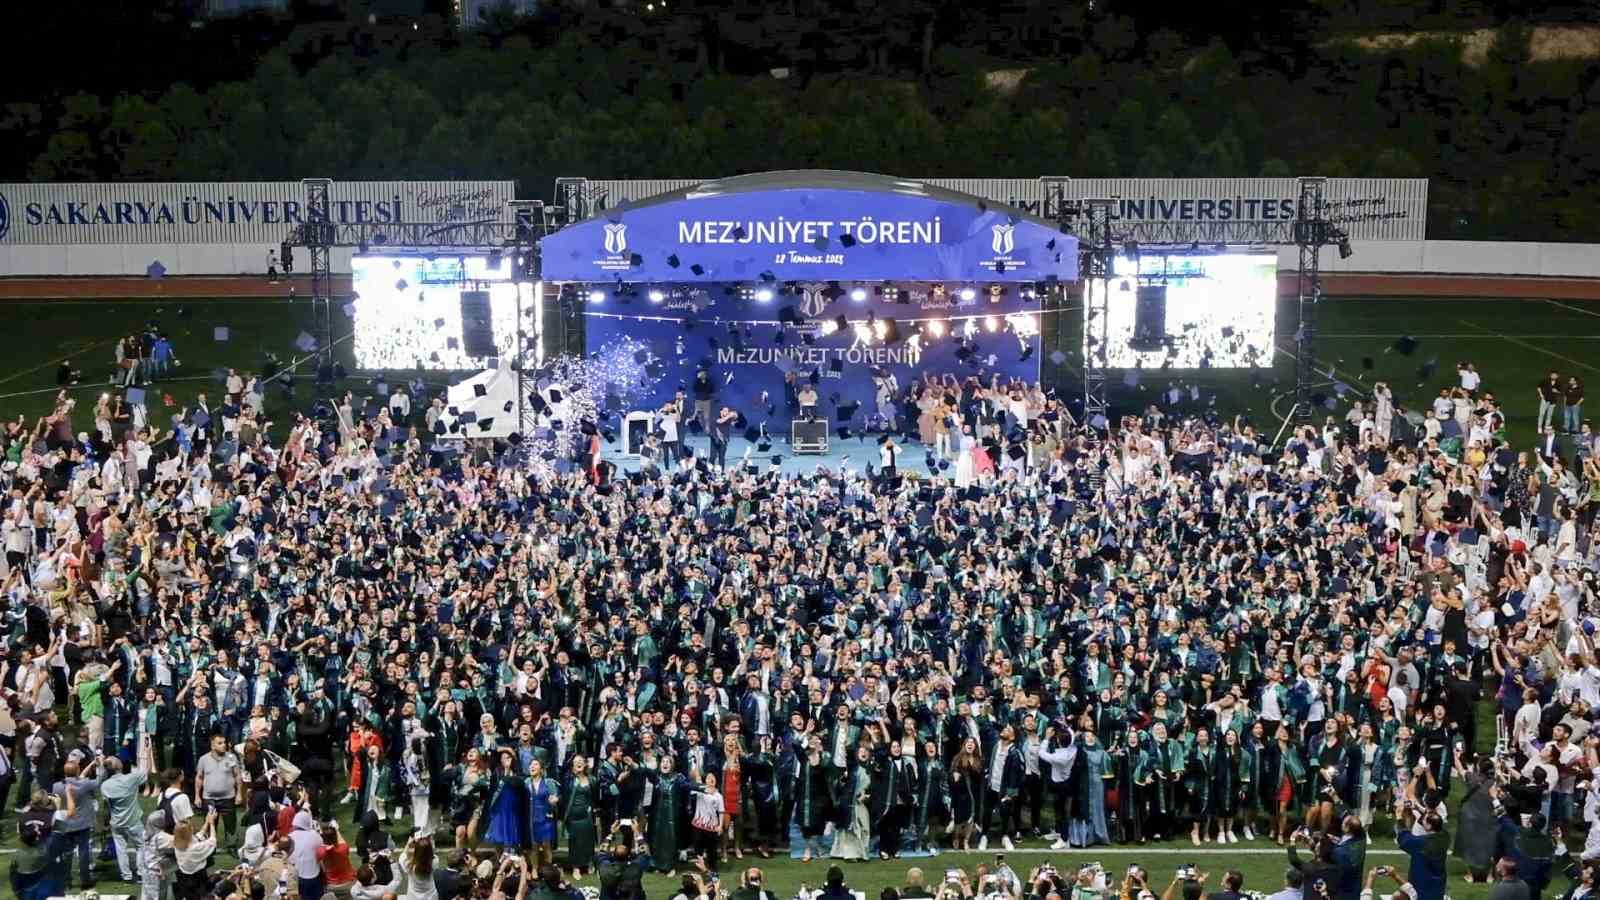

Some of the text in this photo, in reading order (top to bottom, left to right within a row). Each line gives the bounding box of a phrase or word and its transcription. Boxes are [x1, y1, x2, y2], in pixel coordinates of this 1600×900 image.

[26, 201, 175, 226] SAKARYA
[679, 216, 941, 244] MEZUNİYET TÖRENİ
